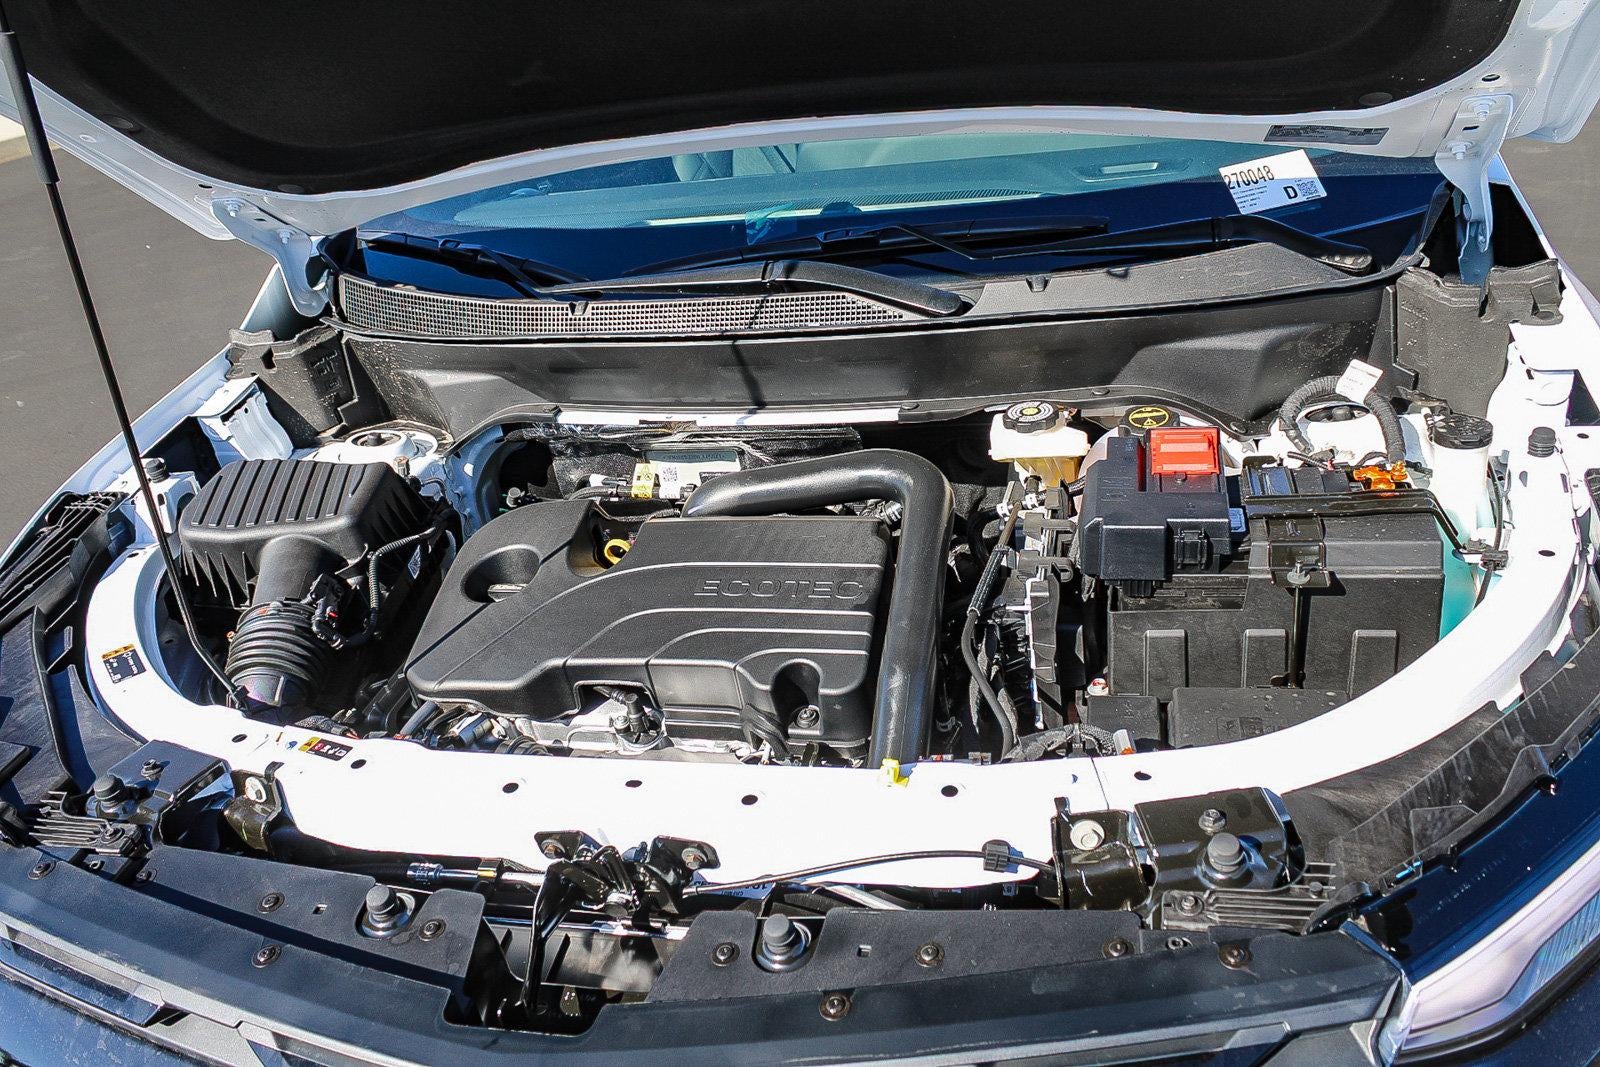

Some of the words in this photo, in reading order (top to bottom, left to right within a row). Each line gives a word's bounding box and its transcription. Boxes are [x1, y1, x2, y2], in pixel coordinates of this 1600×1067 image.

[1223, 165, 1275, 190] 270048
[1283, 185, 1298, 199] D
[693, 580, 863, 600] ECOTEC
